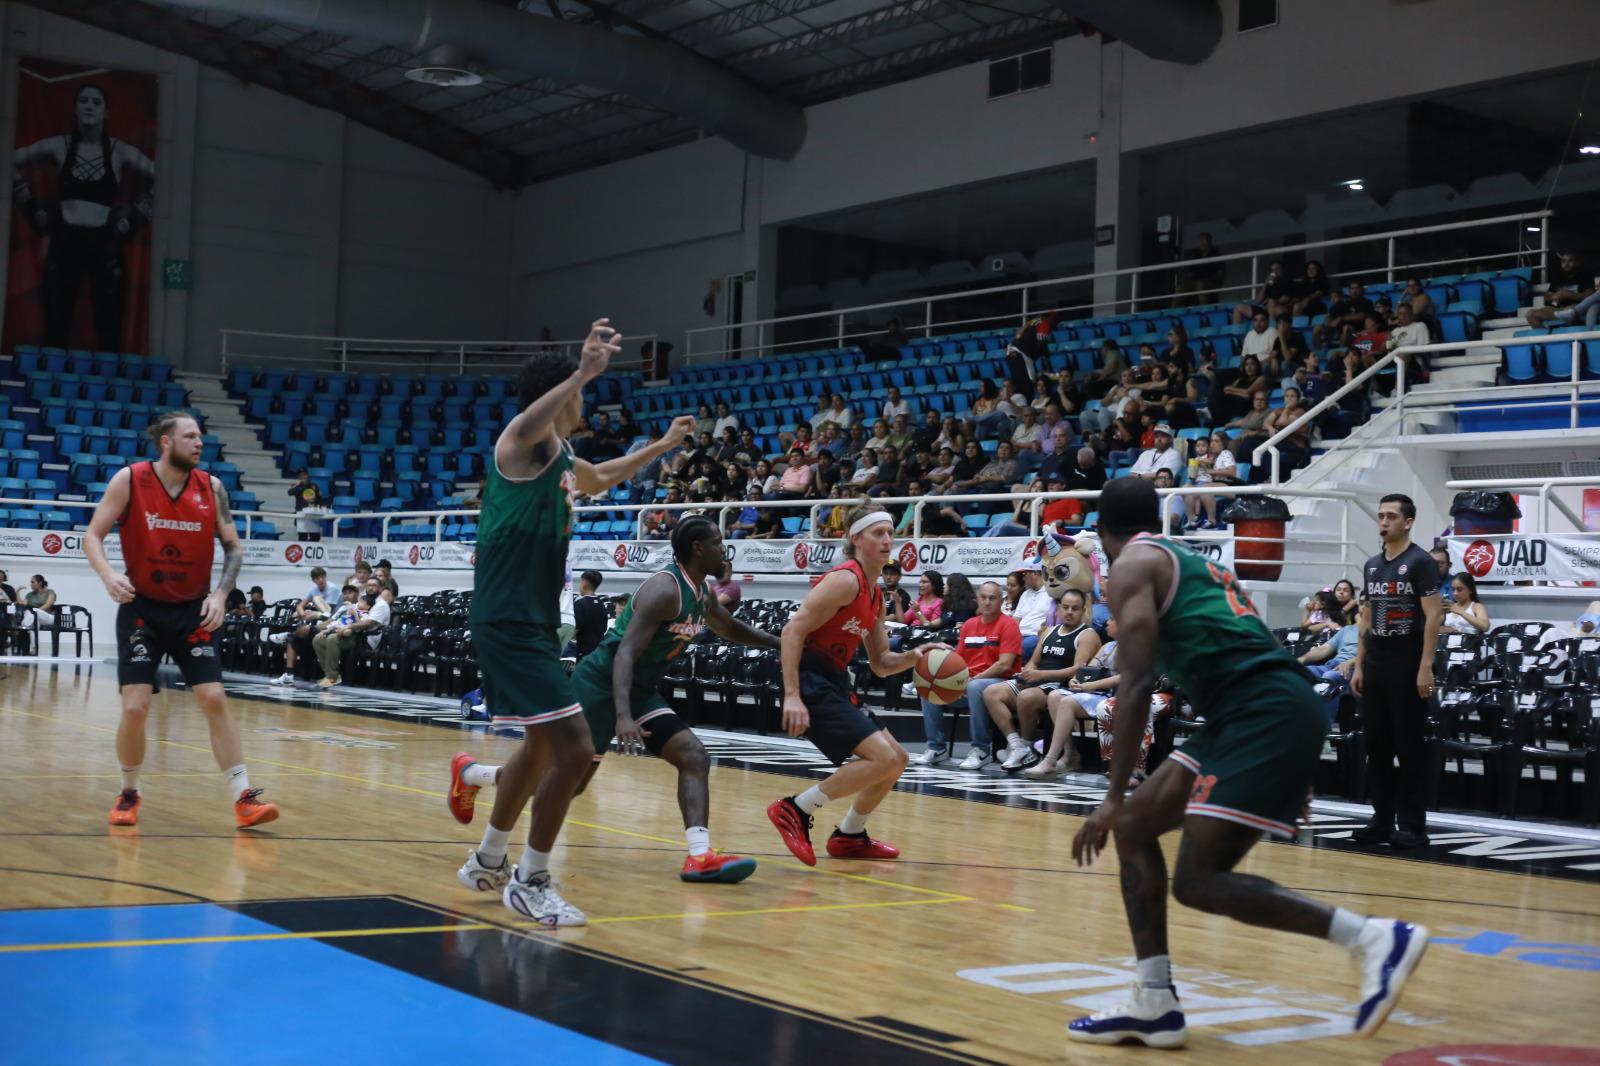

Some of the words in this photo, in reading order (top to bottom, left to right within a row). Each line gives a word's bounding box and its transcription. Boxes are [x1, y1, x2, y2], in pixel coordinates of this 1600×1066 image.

[304, 546, 324, 560] CID
[420, 546, 435, 561] CID
[628, 545, 650, 563] UAD
[809, 545, 836, 564] UAD
[919, 544, 948, 565] CID
[983, 547, 1012, 555] GRANDES
[1497, 539, 1547, 567] UAD
[1043, 645, 1065, 656] B-PRO
